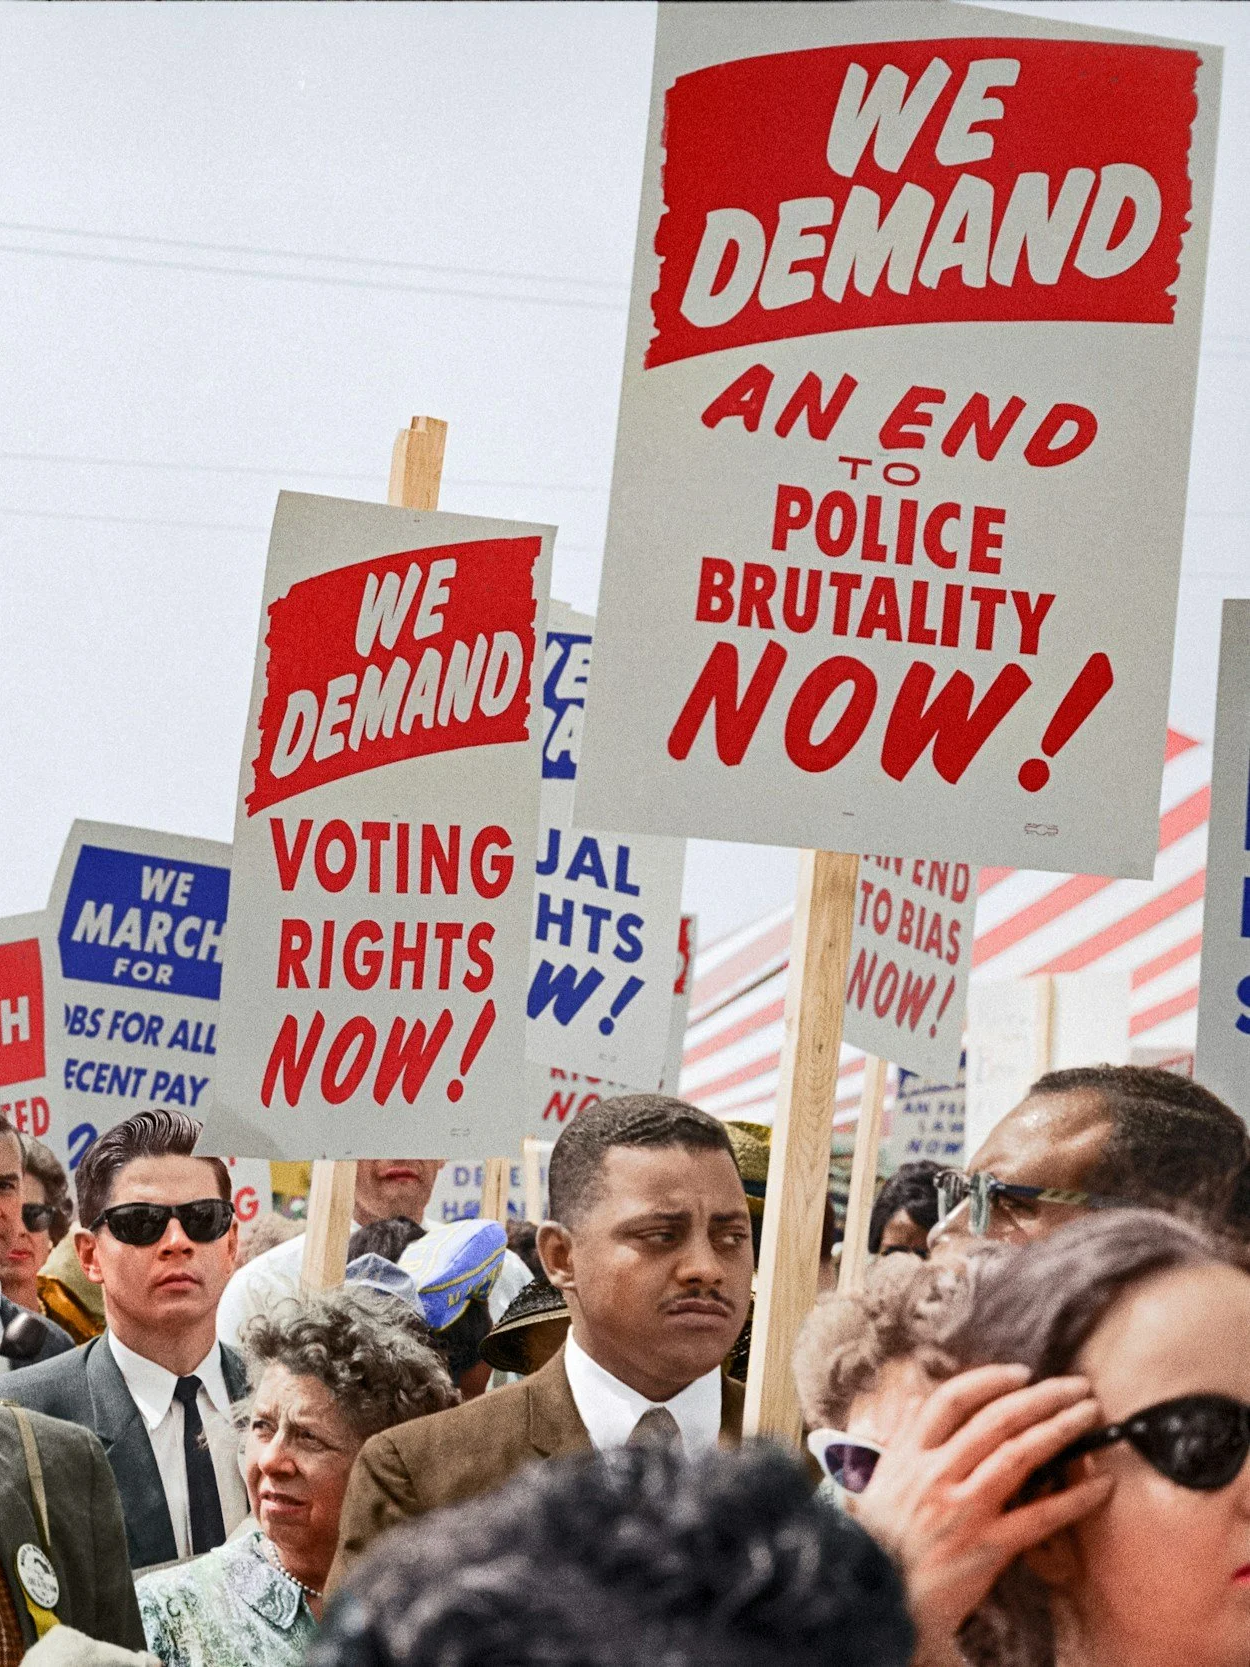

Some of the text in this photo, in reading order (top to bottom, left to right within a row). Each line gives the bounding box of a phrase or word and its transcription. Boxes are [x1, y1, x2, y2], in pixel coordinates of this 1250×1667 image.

[826, 57, 1021, 178] WE
[680, 163, 1162, 329] DEMAND
[700, 363, 1099, 468] AN END
[837, 455, 921, 487] TO
[771, 483, 1007, 575] POLICE
[355, 558, 458, 658] WE
[695, 556, 1057, 656] BRUTALITY
[269, 630, 526, 780] DEMAND
[667, 638, 1114, 794] NOW!
[141, 865, 195, 907] WE
[269, 817, 515, 900] VOTING
[911, 858, 971, 904] END
[71, 900, 227, 964] MARCH
[276, 918, 497, 993] RIGHTS
[860, 879, 962, 966] TO BIAS
[112, 957, 174, 986] FOR
[846, 947, 956, 1039] NOW!
[64, 1003, 217, 1055] BS FOR ALL
[260, 998, 498, 1109] NOW!
[149, 1070, 210, 1107] PAY
